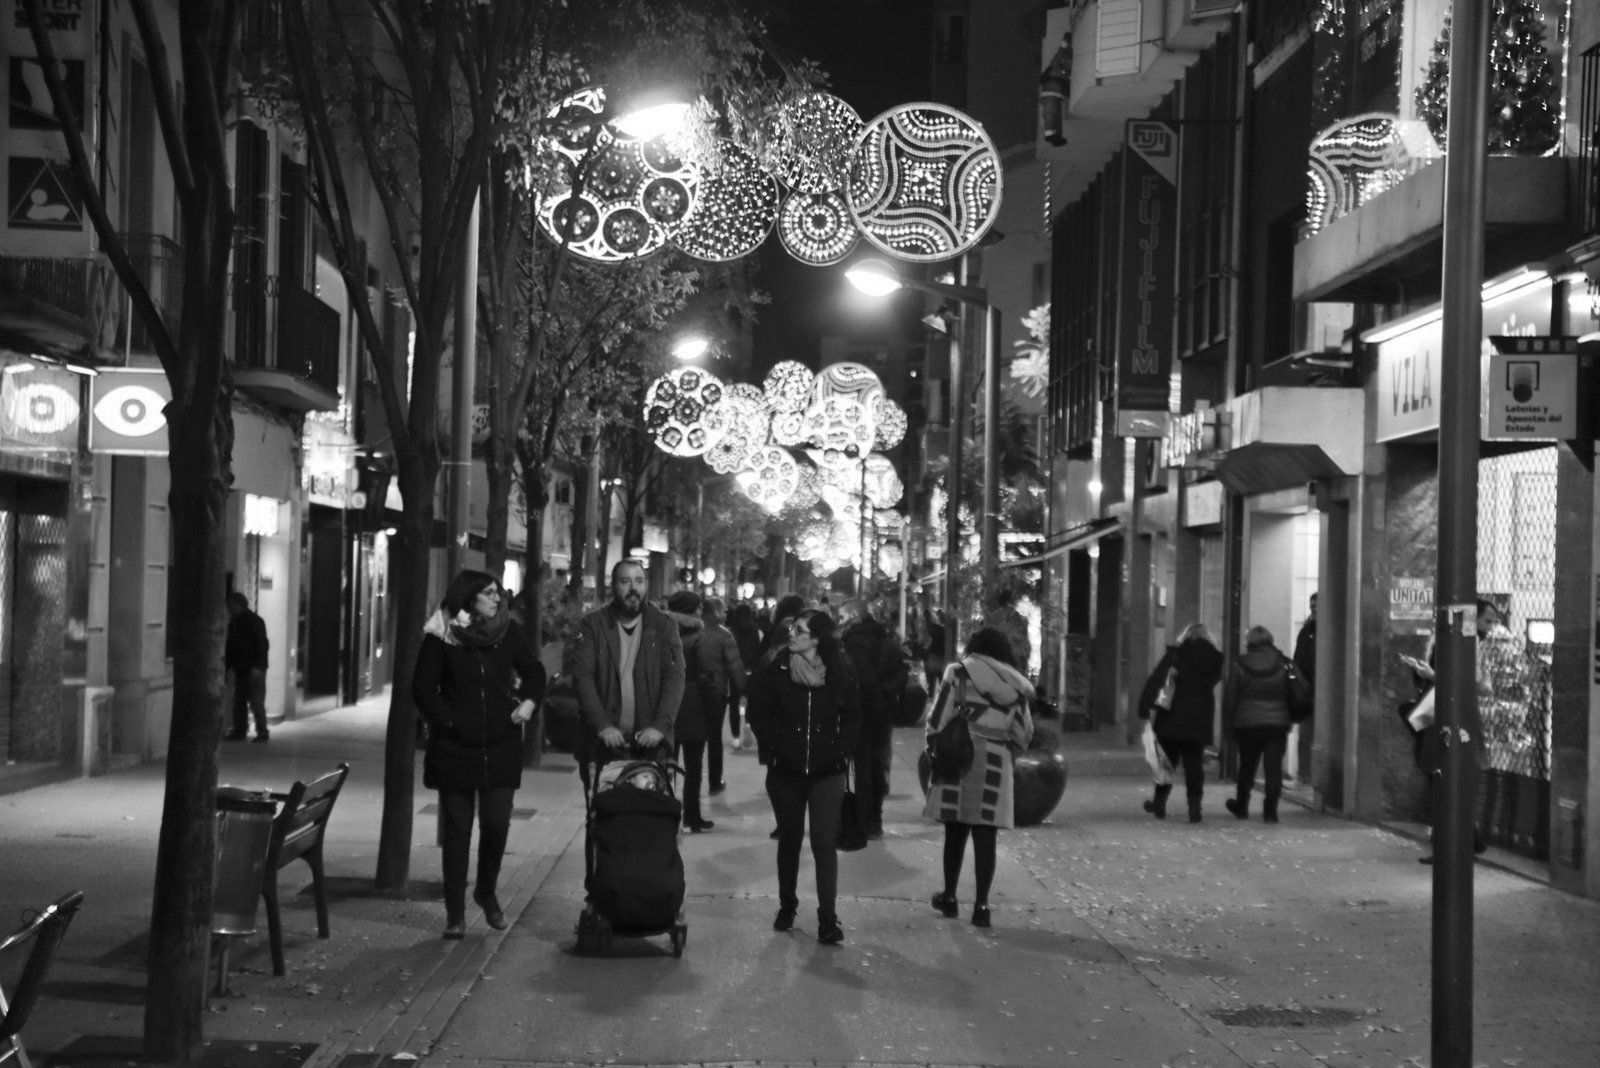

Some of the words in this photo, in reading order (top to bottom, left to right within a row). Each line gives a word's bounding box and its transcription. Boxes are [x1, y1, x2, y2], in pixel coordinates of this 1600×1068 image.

[1133, 126, 1170, 156] FUJI
[1131, 175, 1161, 374] FUJIFILM
[1392, 349, 1432, 417] VILA
[1543, 406, 1549, 416] y
[1506, 414, 1546, 424] Apuestas
[1548, 414, 1562, 423] del
[1505, 424, 1535, 433] Estado
[1392, 589, 1433, 603] UNITAT
